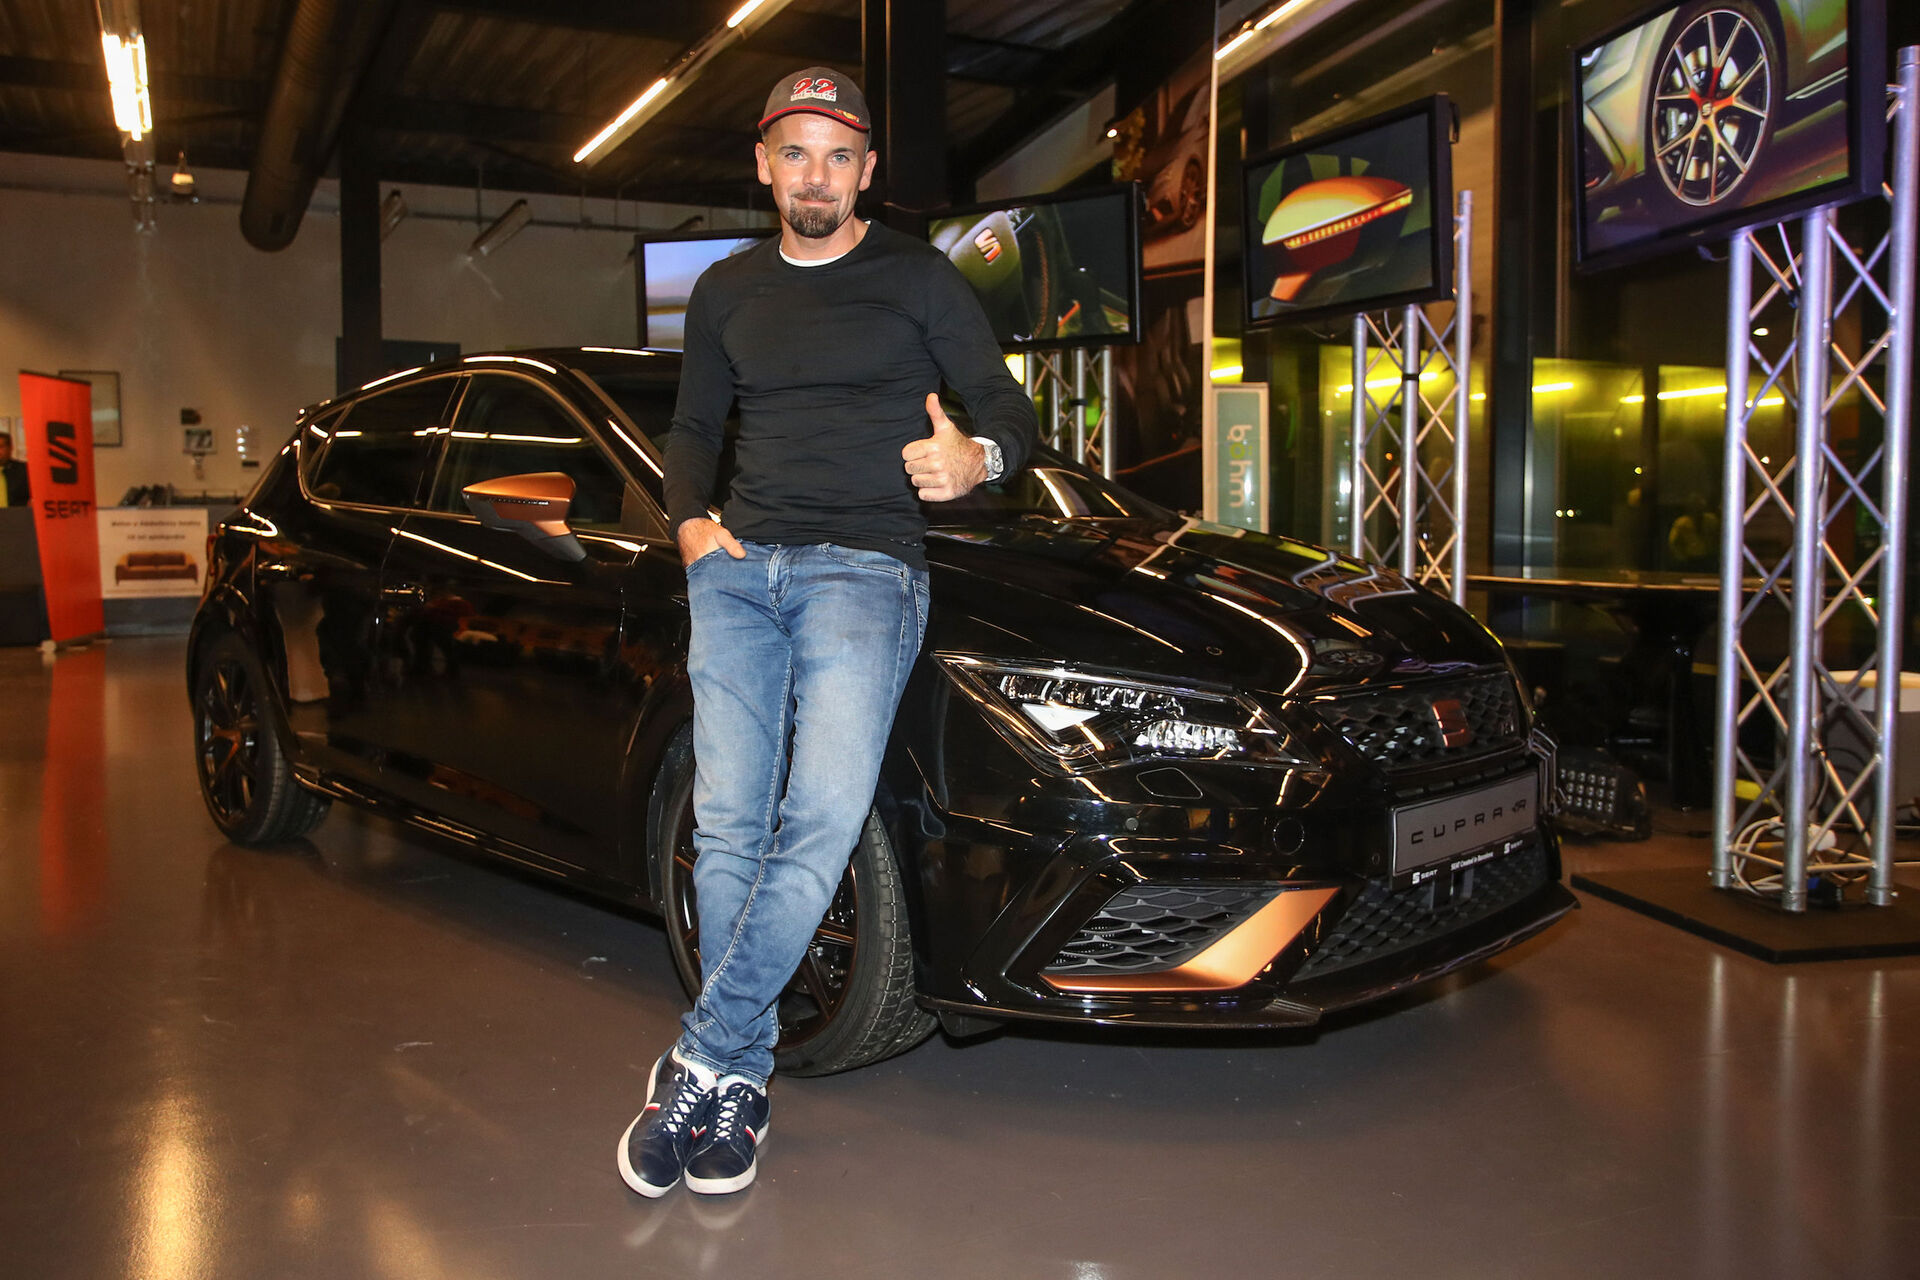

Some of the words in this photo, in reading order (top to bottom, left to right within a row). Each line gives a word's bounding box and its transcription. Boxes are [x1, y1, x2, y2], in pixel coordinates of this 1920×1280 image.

[793, 77, 837, 95] 22
[43, 499, 91, 519] SEAT
[1411, 807, 1503, 845] CUPRA
[1420, 869, 1438, 880] SEAT
